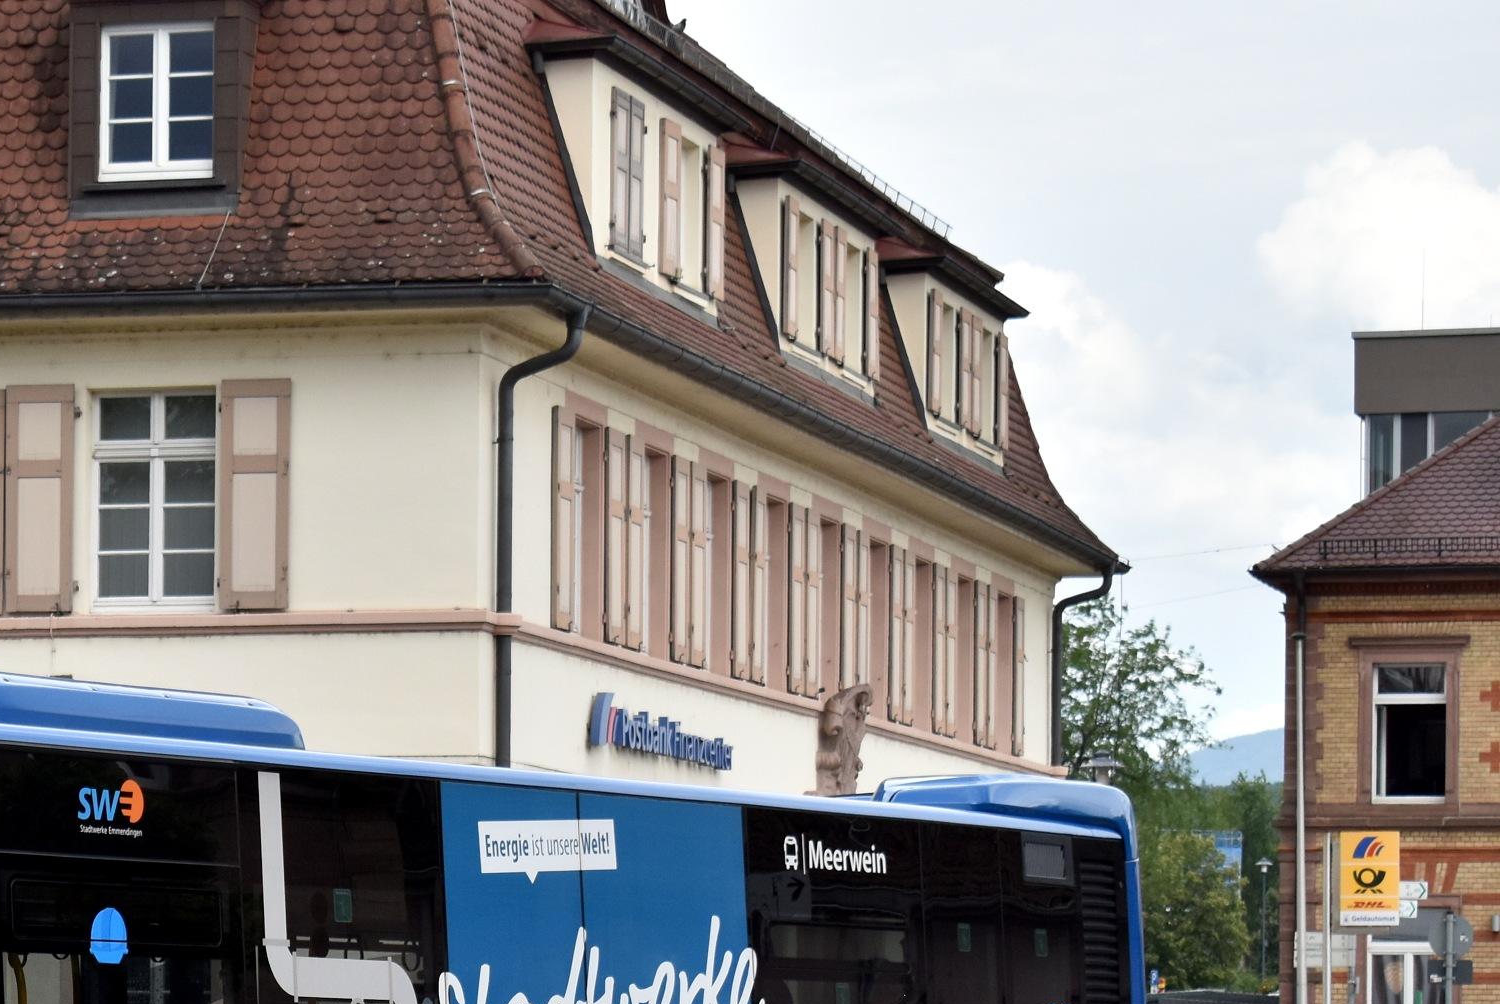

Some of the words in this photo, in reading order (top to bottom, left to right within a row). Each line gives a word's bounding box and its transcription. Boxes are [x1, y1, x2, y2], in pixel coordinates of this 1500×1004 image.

[622, 709, 673, 756] Postbank
[674, 732, 732, 770] Finanzcenter
[80, 825, 107, 835] Stadtwerke
[108, 827, 143, 838] Emmendingen
[485, 833, 529, 860] Energie
[531, 834, 544, 856] ist
[546, 836, 579, 857] unsere
[581, 832, 610, 855] Welt!
[808, 840, 887, 874] Meerwein
[1353, 901, 1386, 909] DHL
[1352, 915, 1396, 923] Geldautomat
